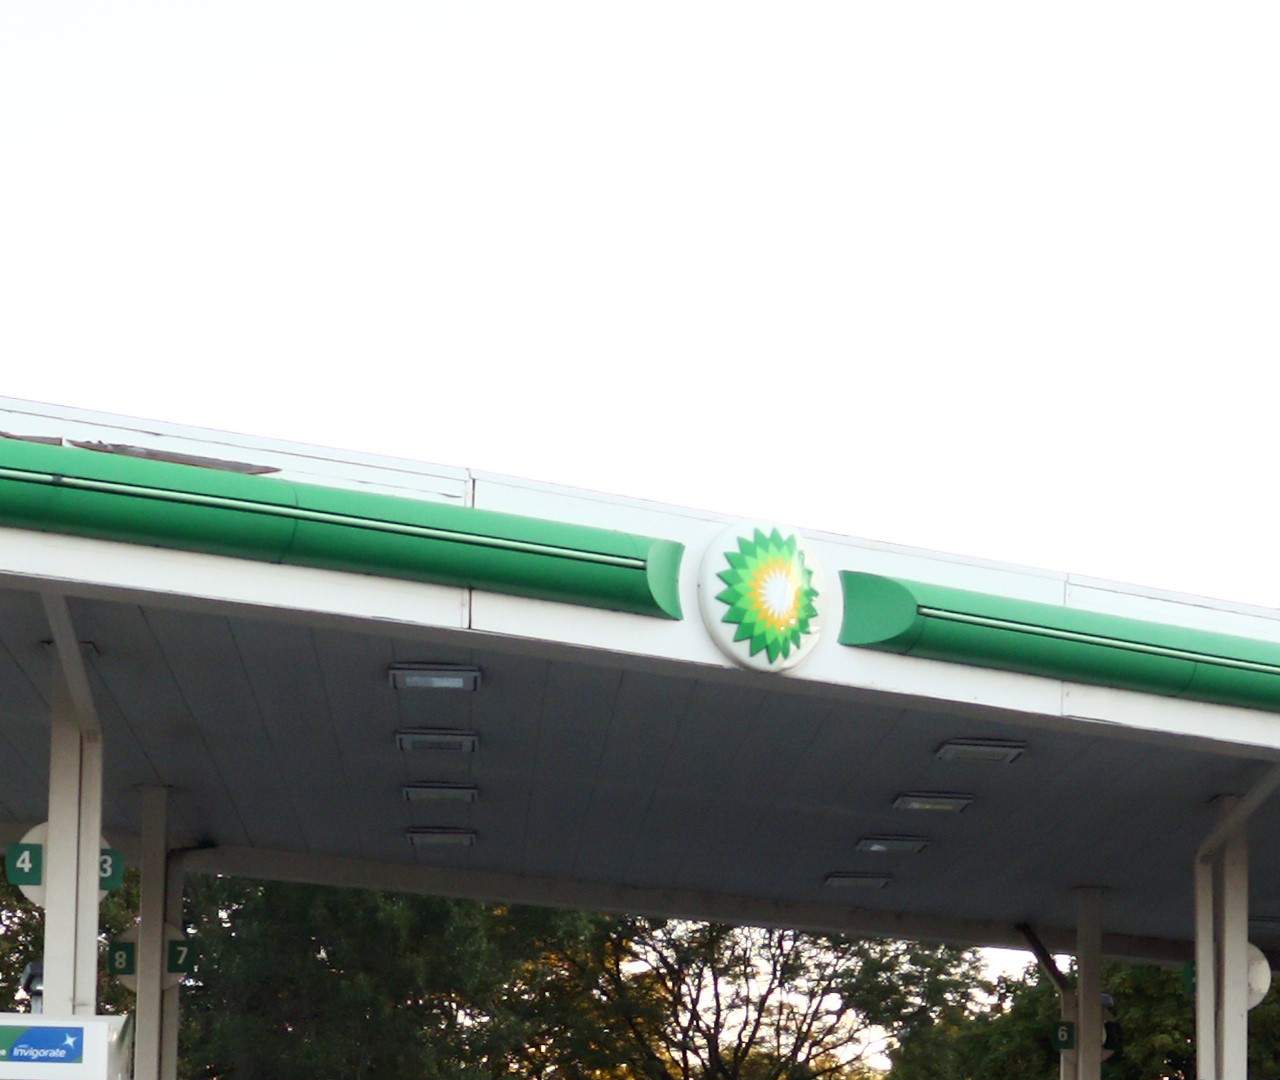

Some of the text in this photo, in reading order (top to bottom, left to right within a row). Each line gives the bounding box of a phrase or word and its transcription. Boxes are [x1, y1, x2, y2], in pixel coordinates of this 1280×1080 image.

[16, 850, 32, 873] 4
[99, 855, 113, 878] 3
[114, 951, 127, 969] 8
[176, 946, 188, 964] 7
[1057, 1026, 1068, 1041] 6
[13, 1047, 66, 1059] Invigorate
